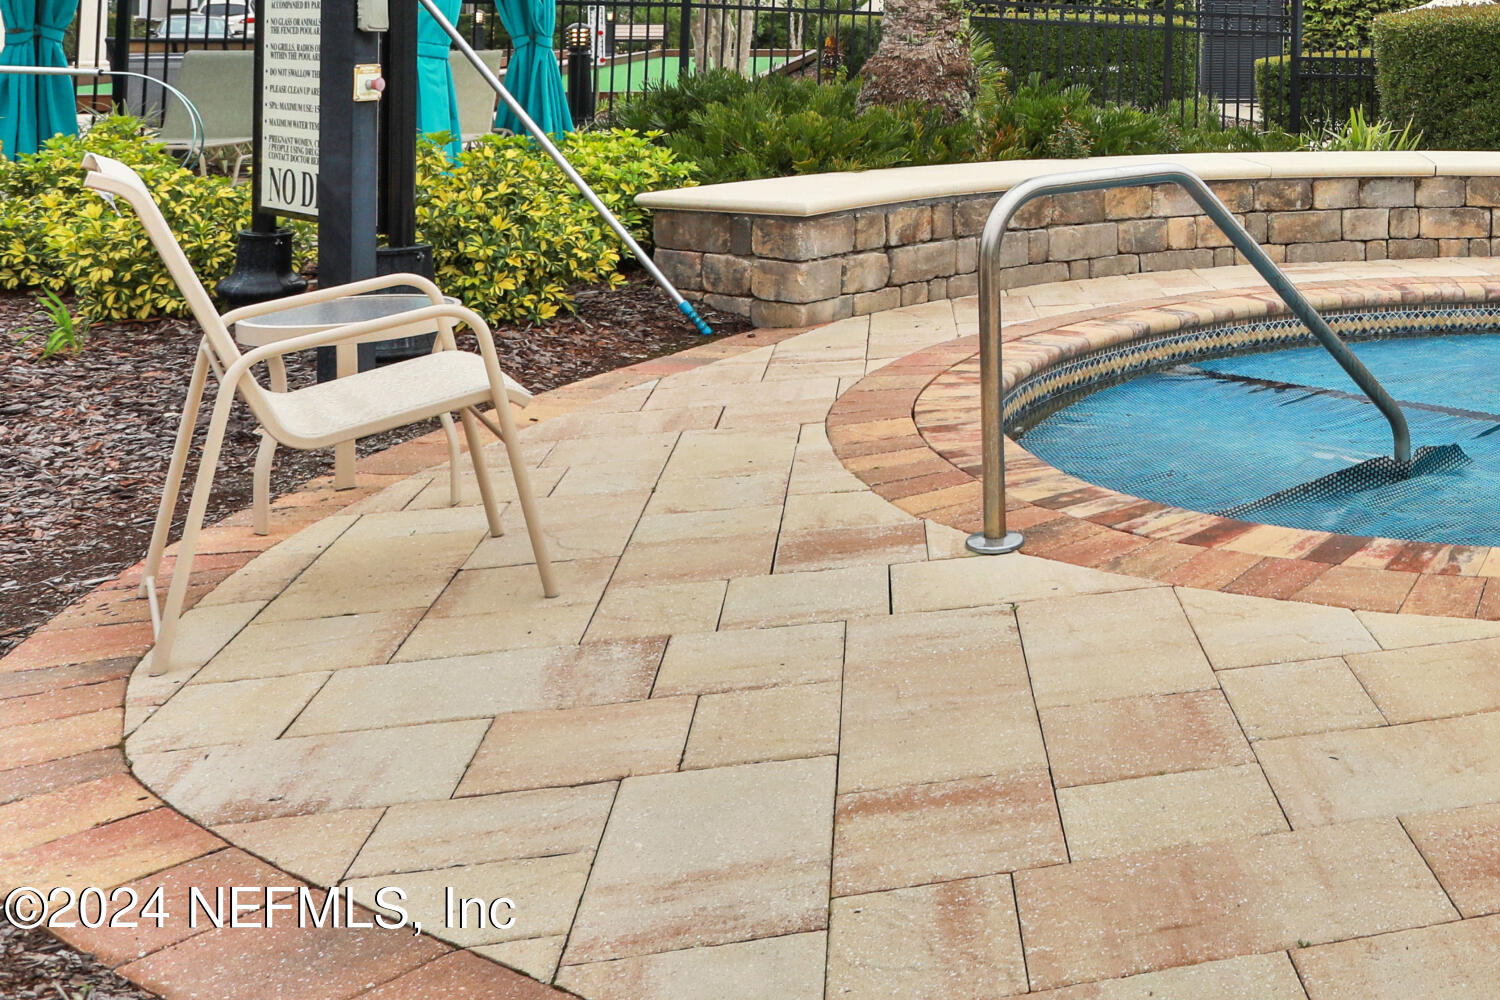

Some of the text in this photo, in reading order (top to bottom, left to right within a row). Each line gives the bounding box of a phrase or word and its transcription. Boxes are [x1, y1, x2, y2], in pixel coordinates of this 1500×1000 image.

[272, 1, 304, 9] ACCOMPANIED
[304, 1, 310, 9] BY
[271, 18, 278, 26] NO
[278, 18, 292, 26] GLASS
[293, 18, 300, 26] OR
[271, 26, 280, 34] THE
[280, 26, 300, 34] FENCED
[300, 26, 312, 35] POOL
[271, 43, 278, 51] NO
[270, 52, 288, 60] WITHIN
[288, 52, 297, 60] THE
[298, 52, 311, 60] POOL
[278, 68, 287, 76] NOT
[288, 68, 310, 78] SWALLOW
[270, 84, 287, 93] PLEASE
[288, 86, 303, 94] CLEAN
[304, 87, 310, 95] UP
[280, 102, 302, 112] MAXIMUM
[269, 118, 292, 128] MAXIMUM
[293, 120, 308, 130] WATER
[268, 135, 294, 144] PREGNANT
[290, 146, 304, 154] USING
[268, 152, 290, 162] CONTACT
[290, 154, 310, 164] DOCTOR
[269, 167, 296, 205] NO
